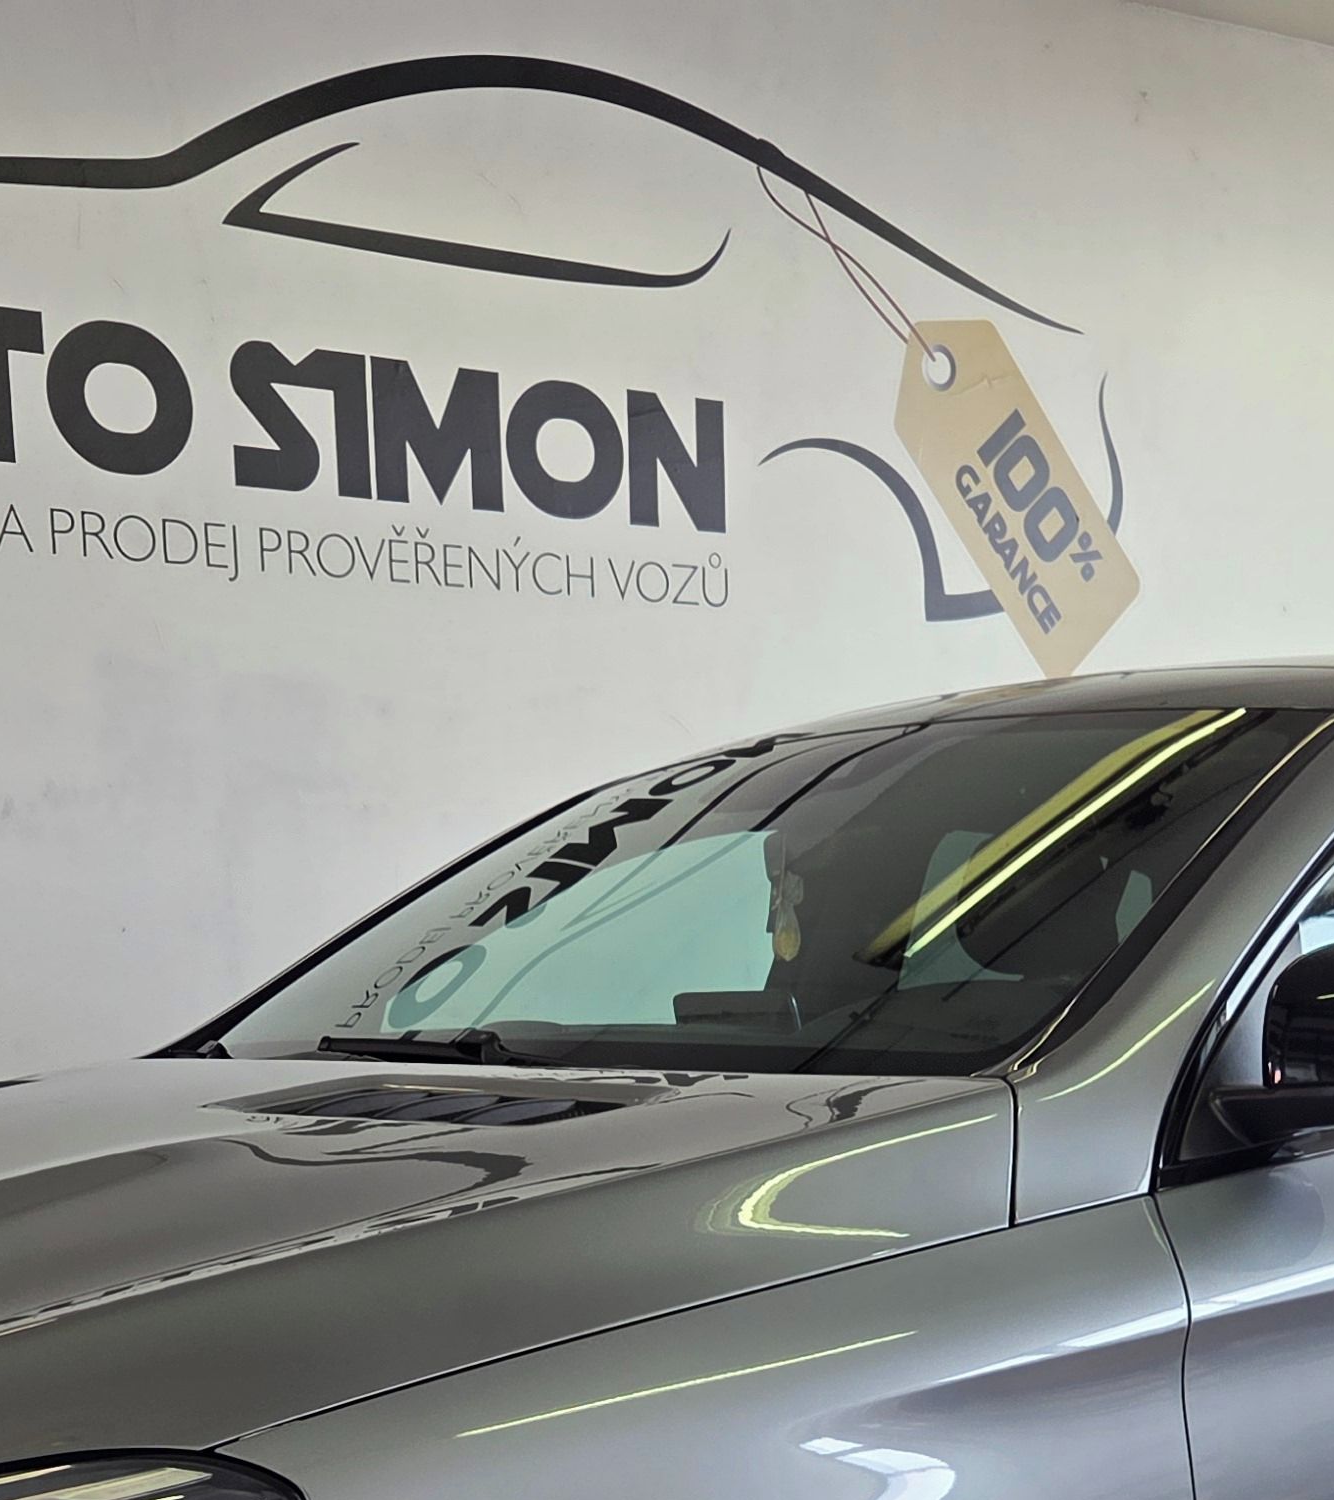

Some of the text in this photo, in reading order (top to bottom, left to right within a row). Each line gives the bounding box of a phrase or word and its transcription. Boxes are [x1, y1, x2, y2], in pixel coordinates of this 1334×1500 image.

[49, 507, 241, 583] PRODEJ
[258, 523, 597, 599] PROVĚŘENÝCH
[607, 550, 730, 609] VOZŮ
[954, 464, 1062, 636] GARANCE
[976, 408, 1104, 583] 100%
